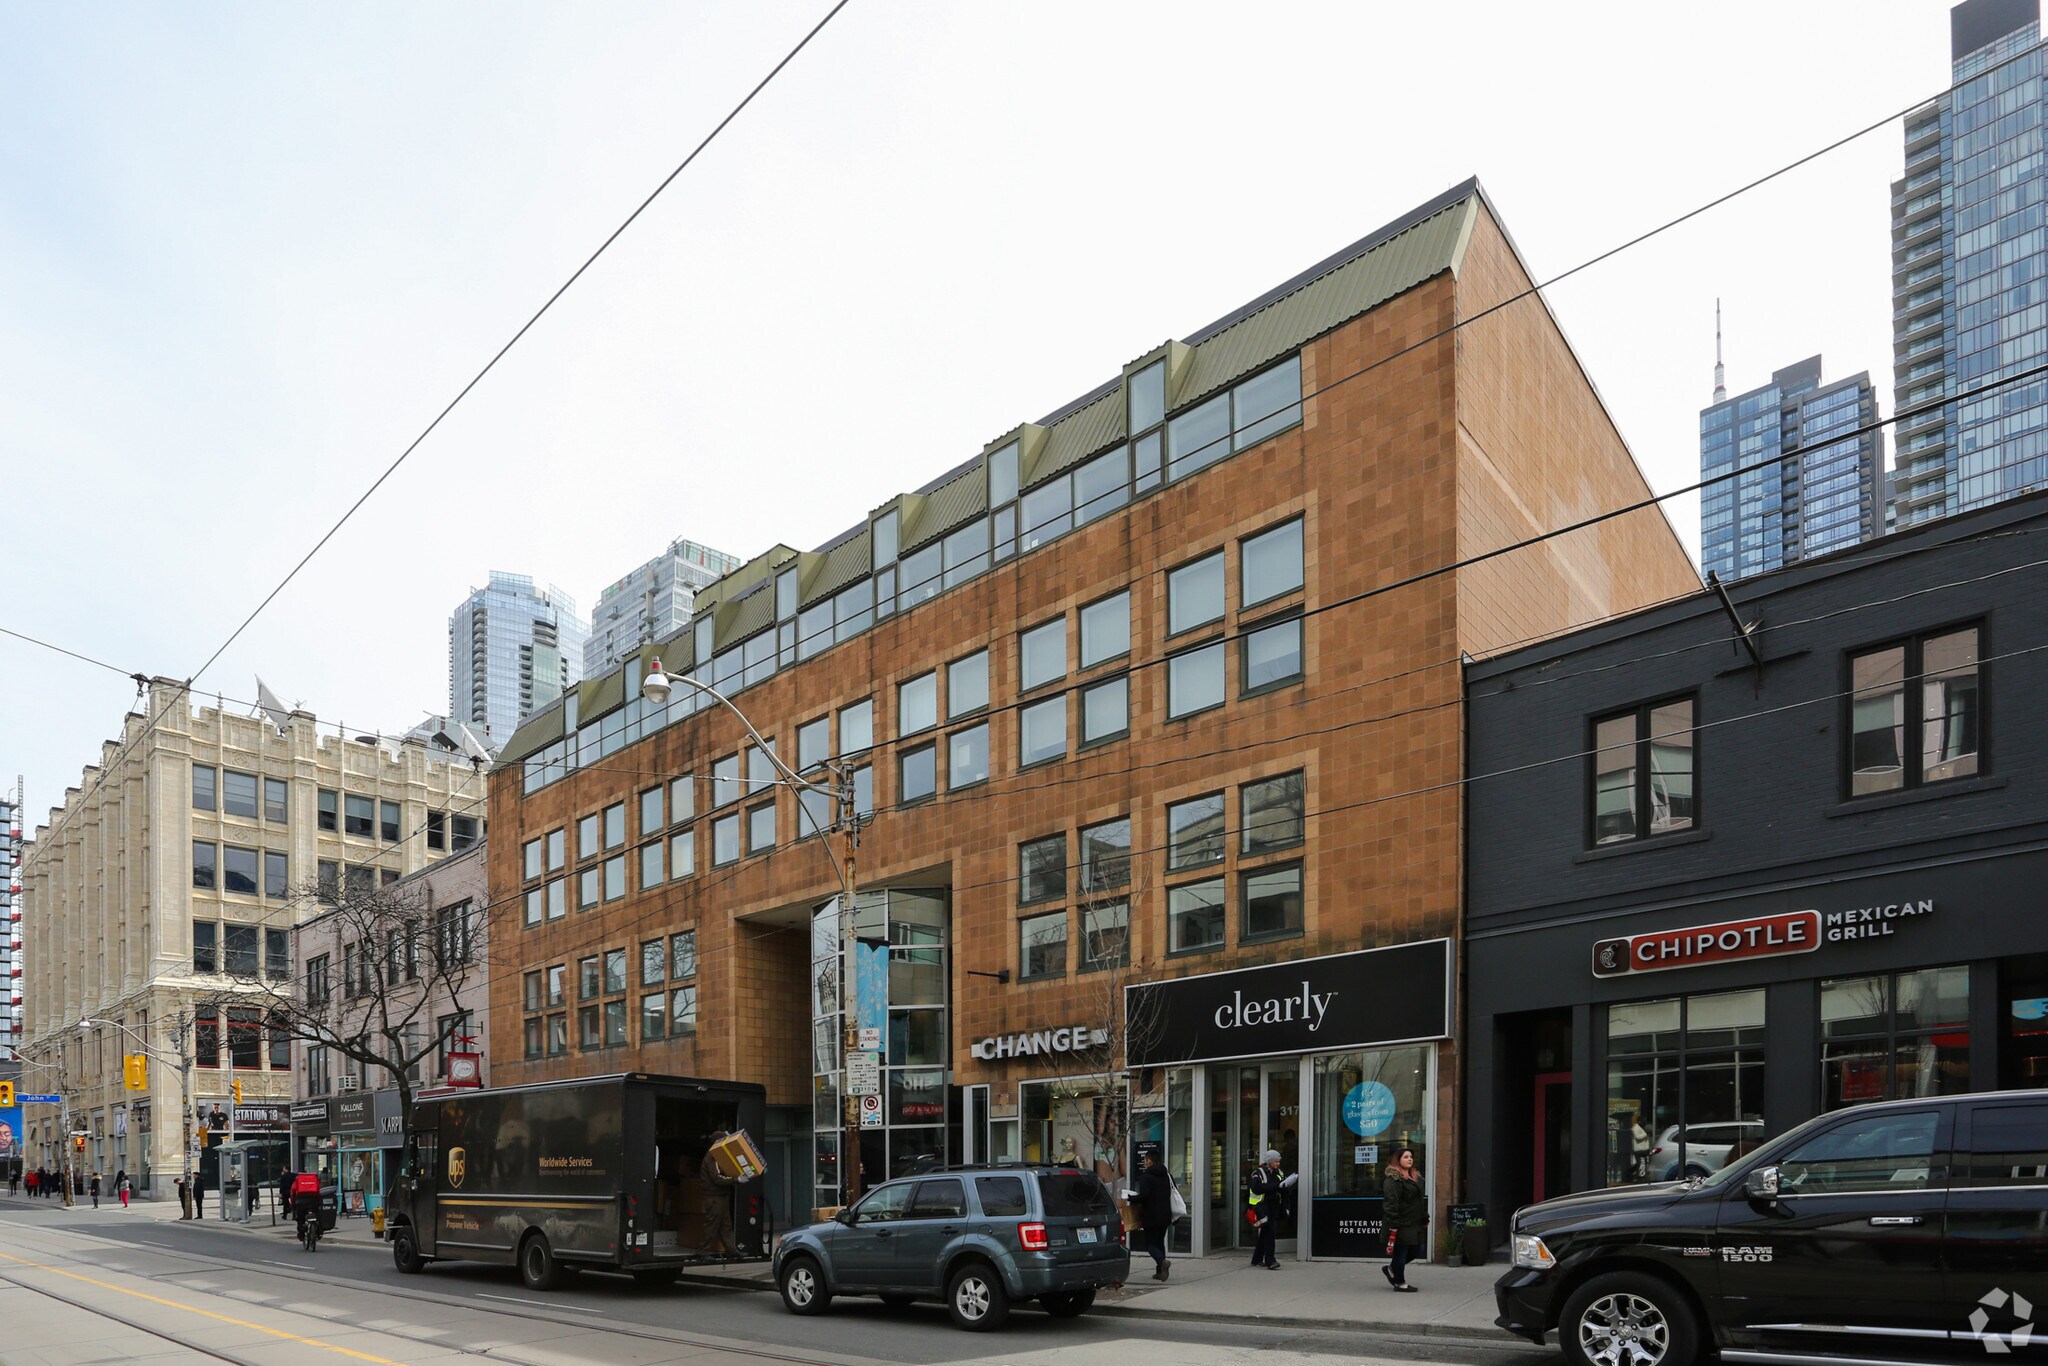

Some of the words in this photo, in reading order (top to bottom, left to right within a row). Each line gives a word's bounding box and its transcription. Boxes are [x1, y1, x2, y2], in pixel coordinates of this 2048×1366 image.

[1826, 898, 1934, 927] MEXICAN
[1827, 921, 1895, 942] GRILL
[1636, 919, 1807, 962] CHIPOTLE
[1214, 980, 1333, 1031] clearly
[980, 1026, 1088, 1060] CHANGE
[1361, 1089, 1373, 1097] Get
[1357, 1100, 1376, 1108] pairs
[234, 1109, 267, 1120] STATION
[1280, 1105, 1300, 1116] 317
[1372, 1108, 1389, 1116] from
[1359, 1119, 1378, 1128] $50
[538, 1157, 568, 1168] Worldwide
[568, 1156, 593, 1168] Services
[450, 1159, 464, 1182] ups
[446, 1220, 463, 1230] Propane
[463, 1221, 480, 1230] Vehicle
[1722, 1246, 1773, 1255] RAM
[1722, 1254, 1773, 1262] 1500
